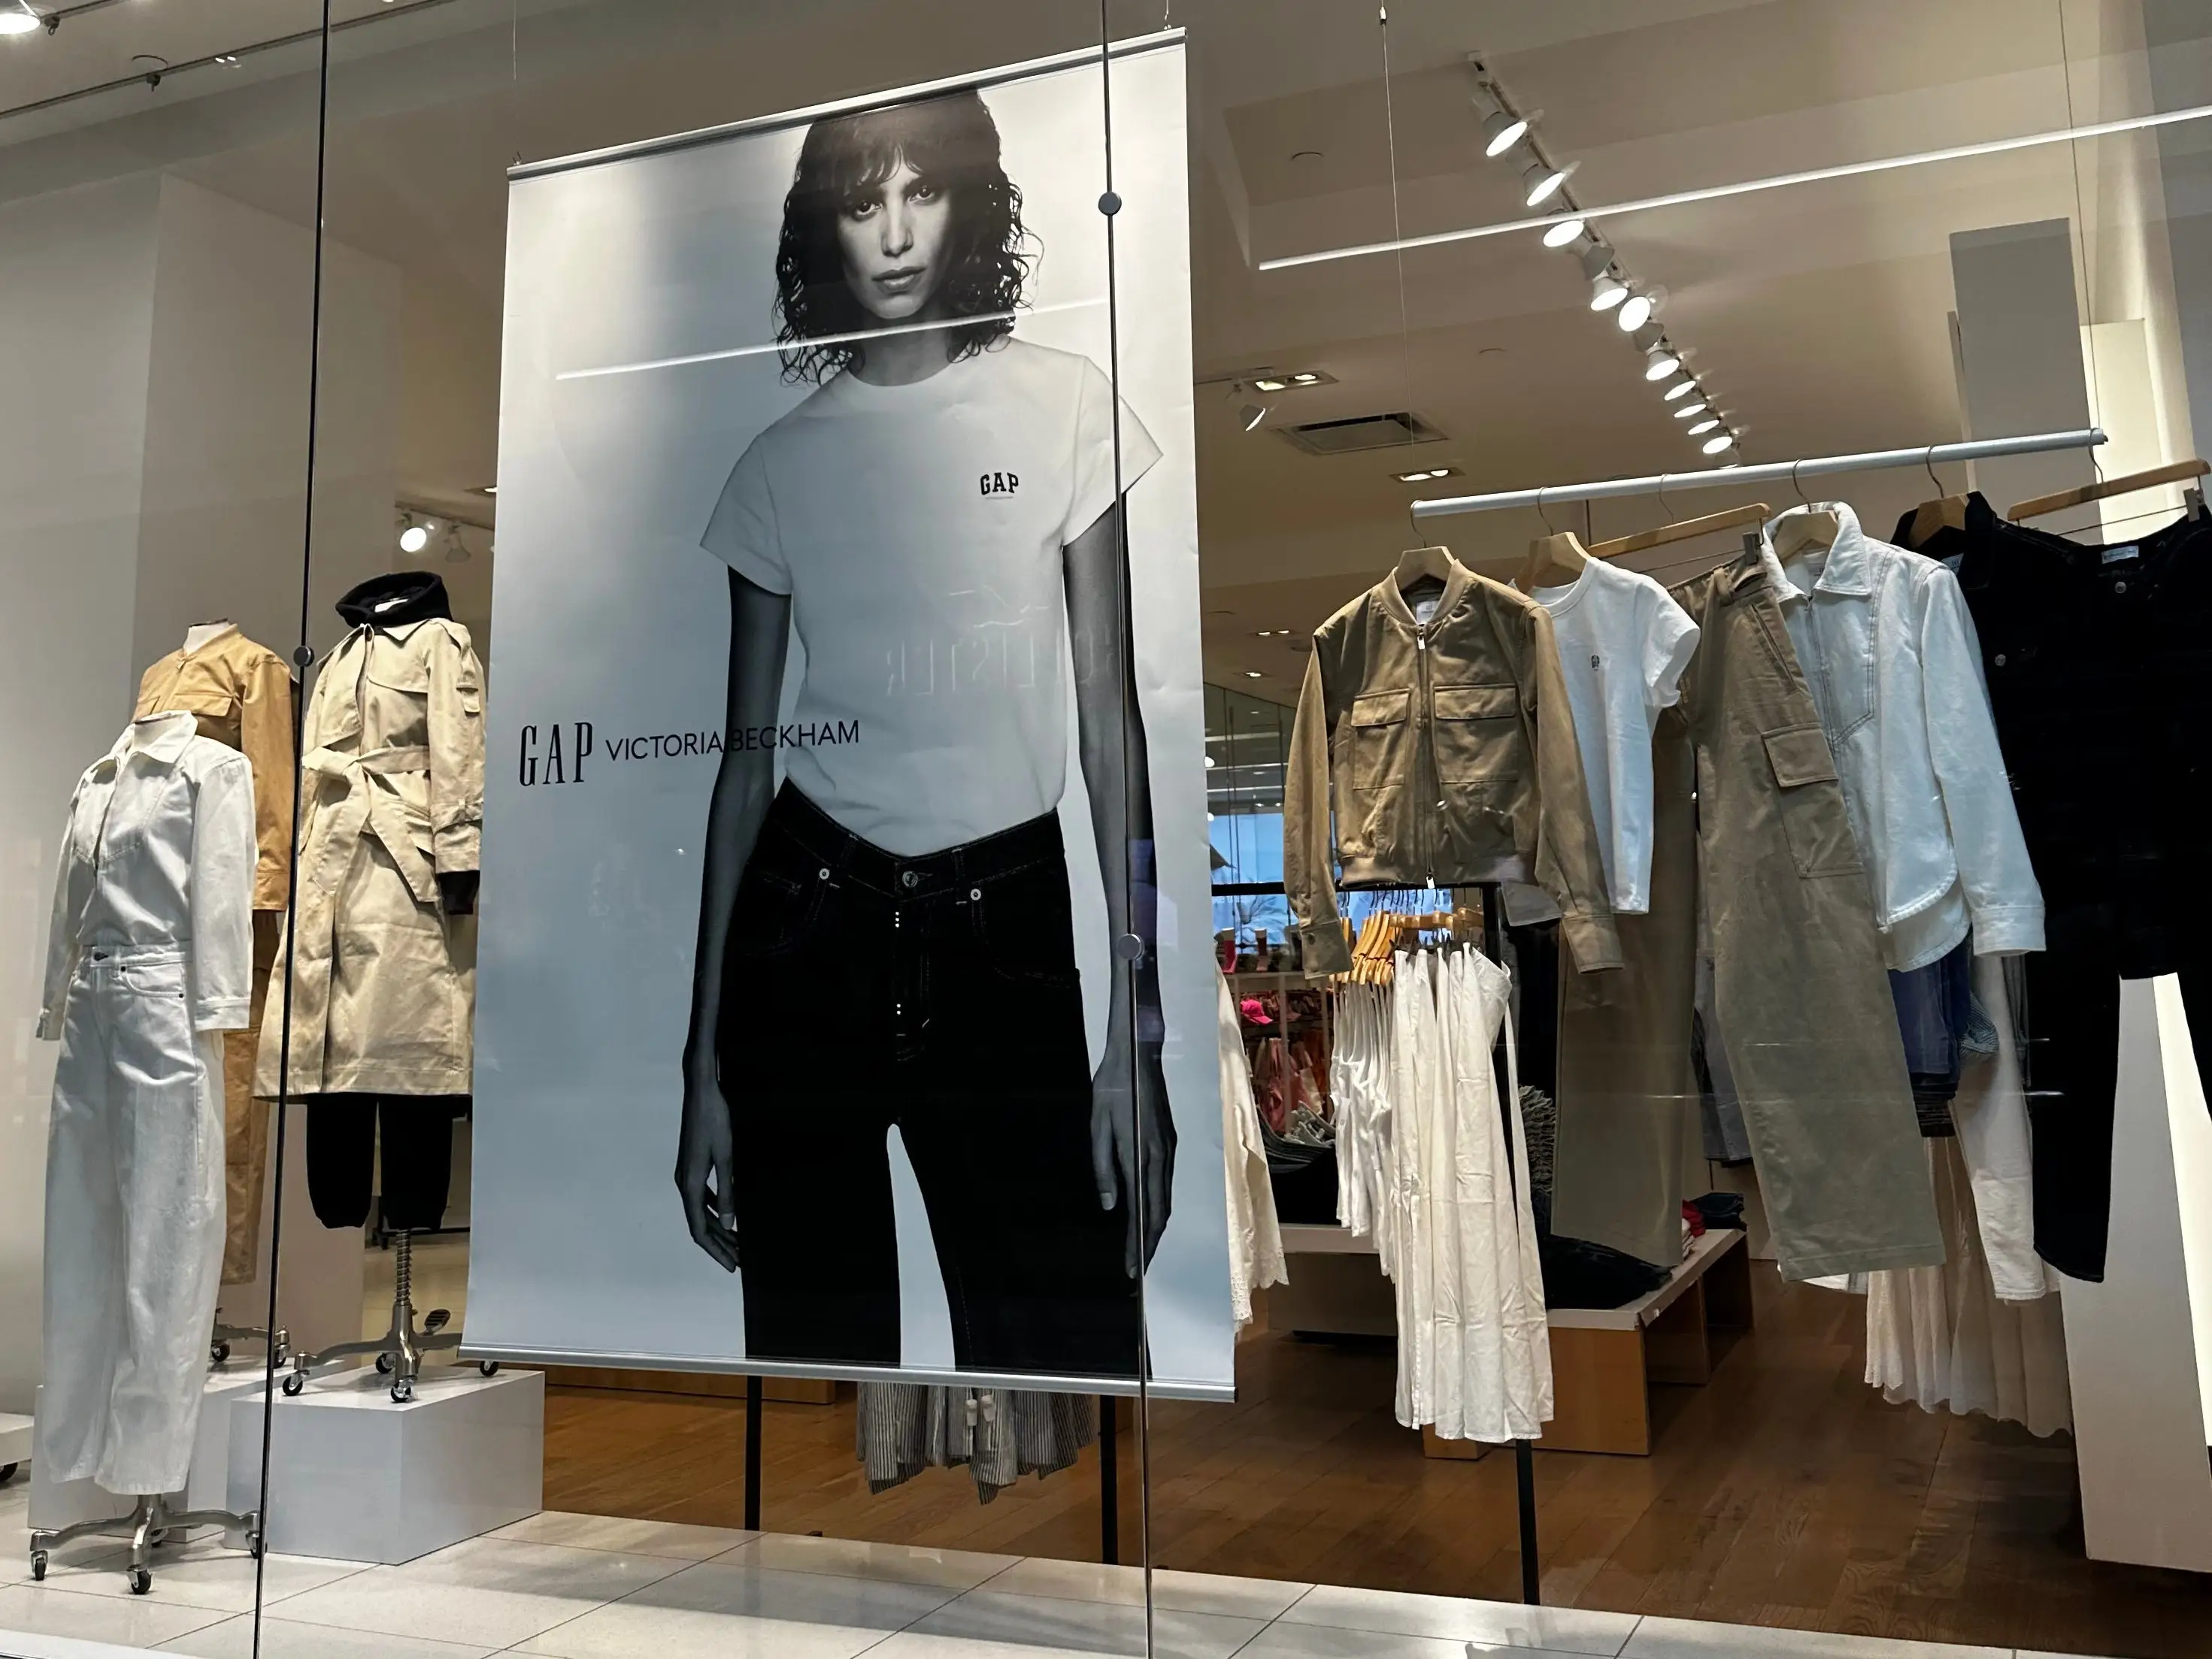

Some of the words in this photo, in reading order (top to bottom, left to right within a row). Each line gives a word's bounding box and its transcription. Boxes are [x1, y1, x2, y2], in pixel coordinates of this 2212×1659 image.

[980, 471, 1019, 495] GAP
[520, 722, 592, 786] GAP
[605, 731, 723, 761] VICTORIA
[730, 720, 859, 752] BECKHAM
